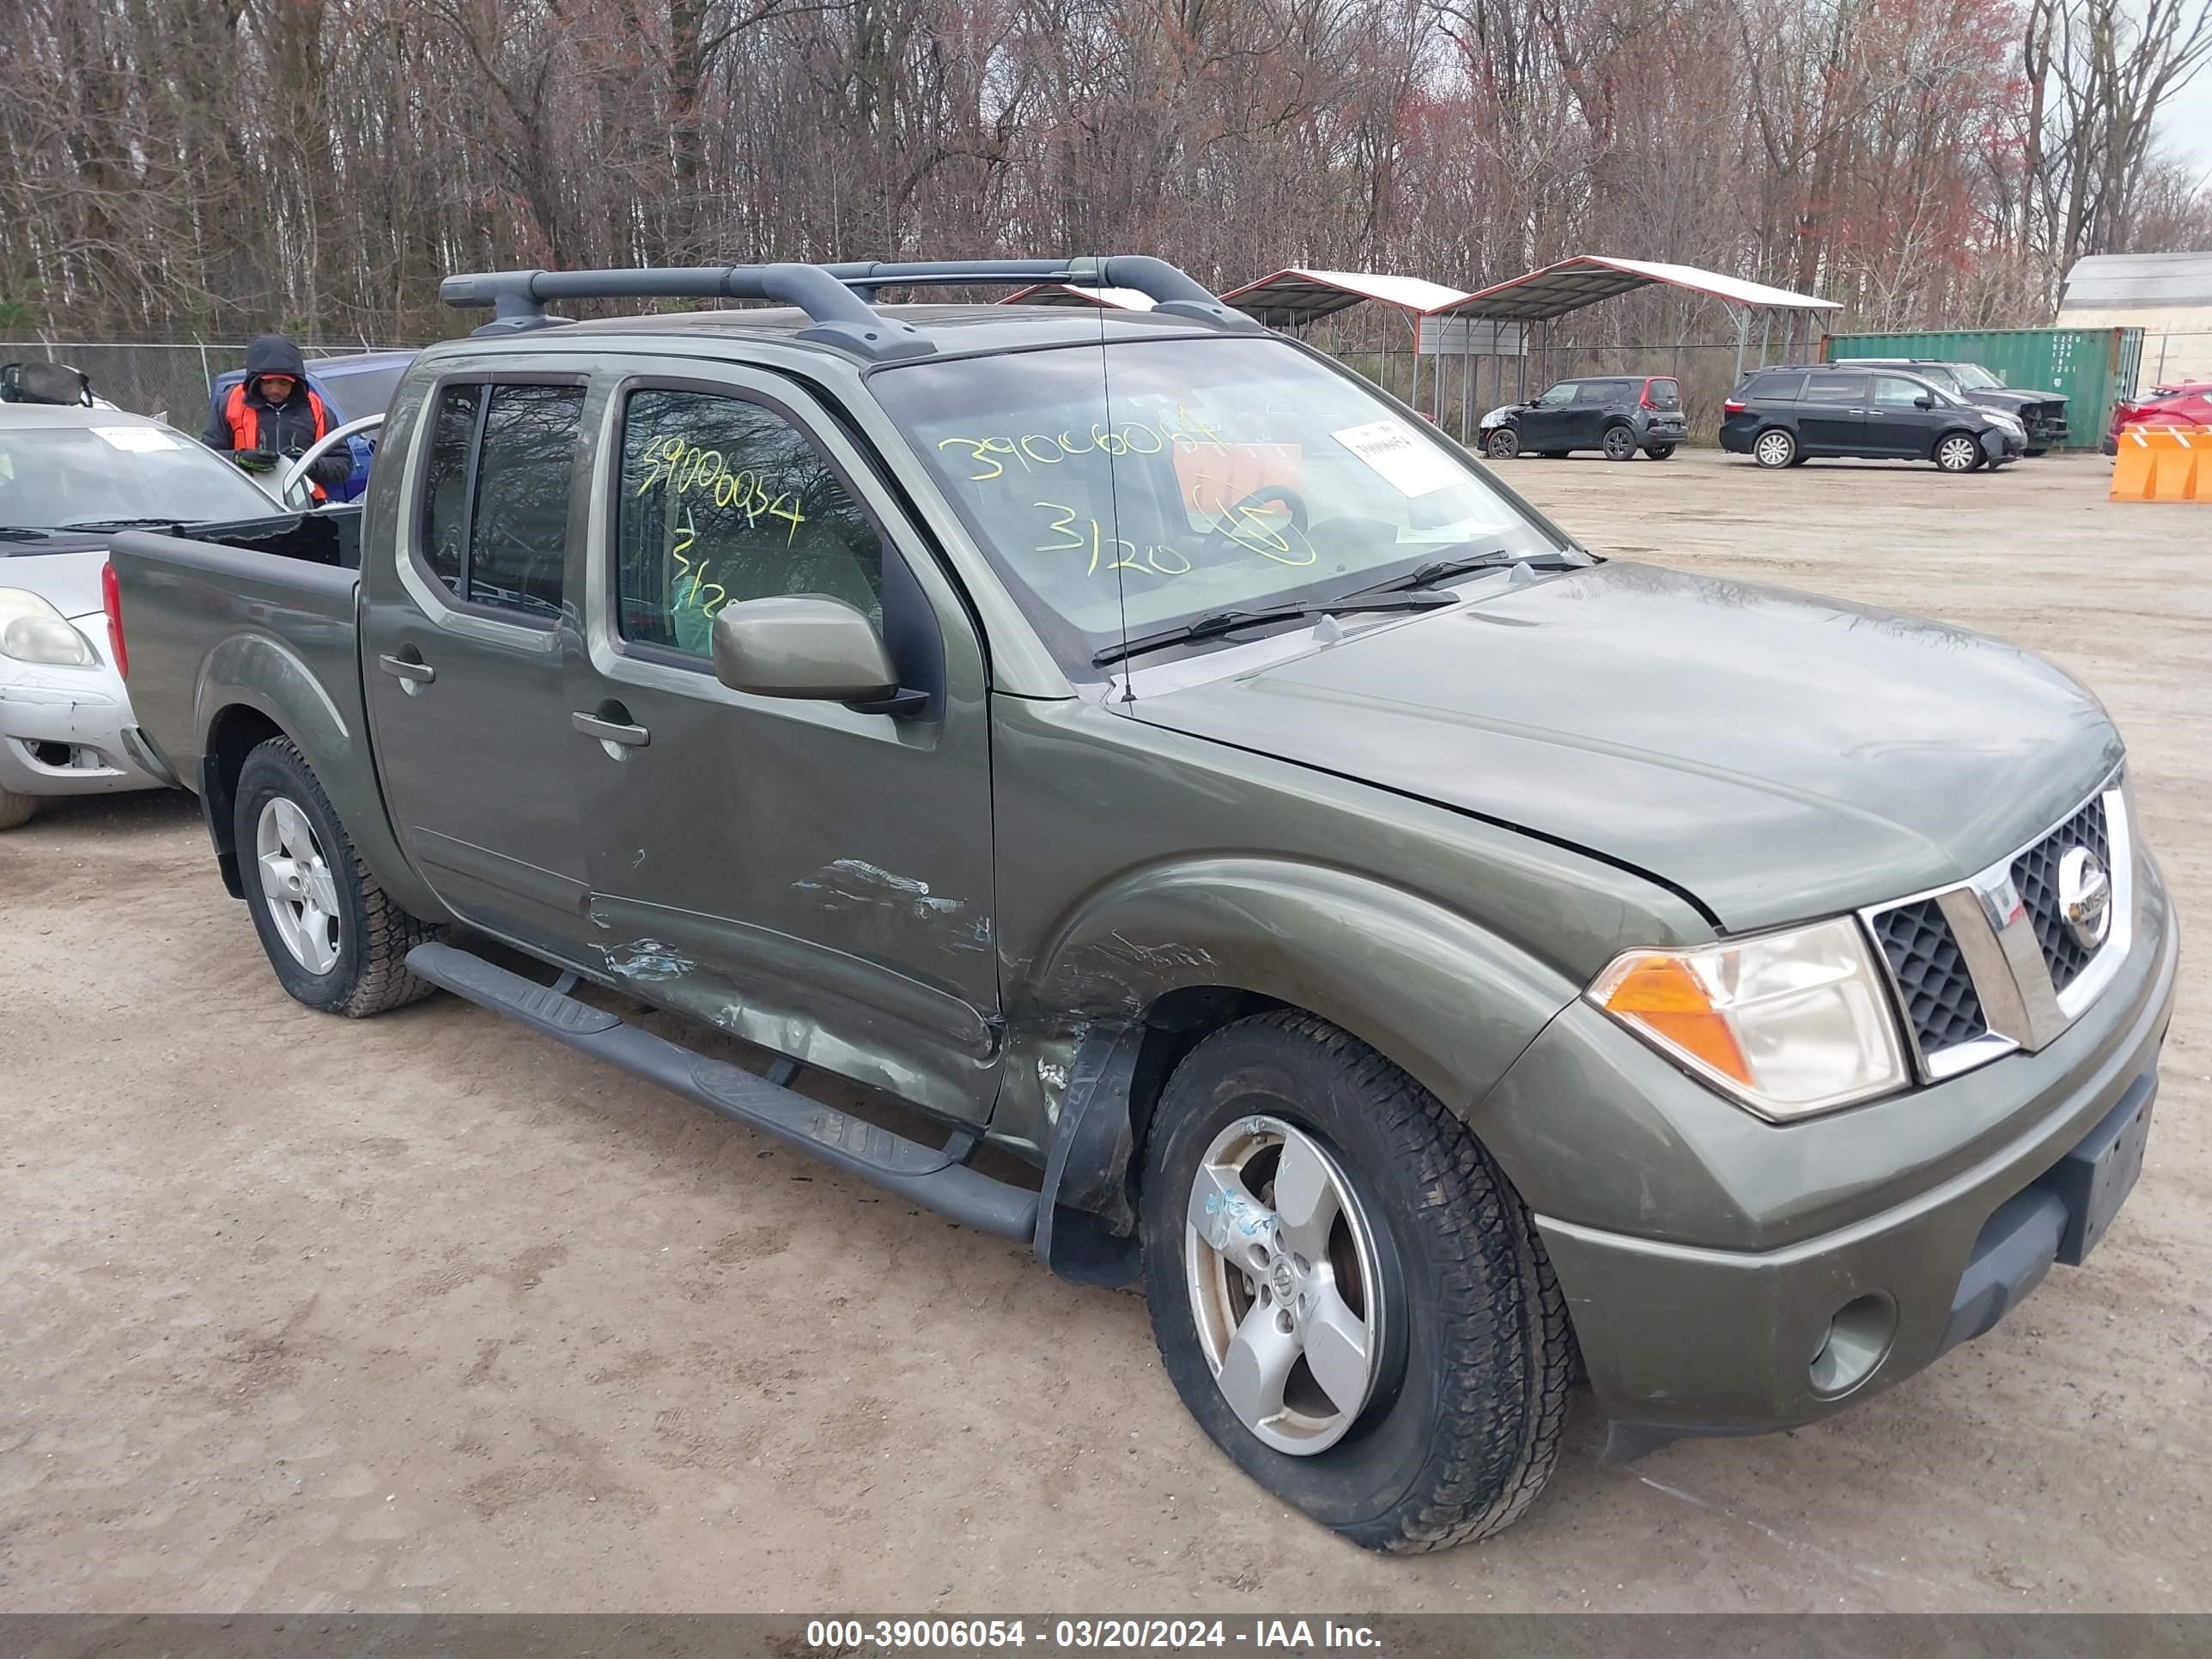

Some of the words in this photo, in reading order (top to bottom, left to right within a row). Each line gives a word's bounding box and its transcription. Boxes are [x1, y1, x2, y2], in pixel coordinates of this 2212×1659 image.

[938, 404, 1231, 481] 39006054
[636, 434, 805, 550] 39006054
[671, 527, 740, 618] 3/2
[1032, 501, 1192, 578] 3/20
